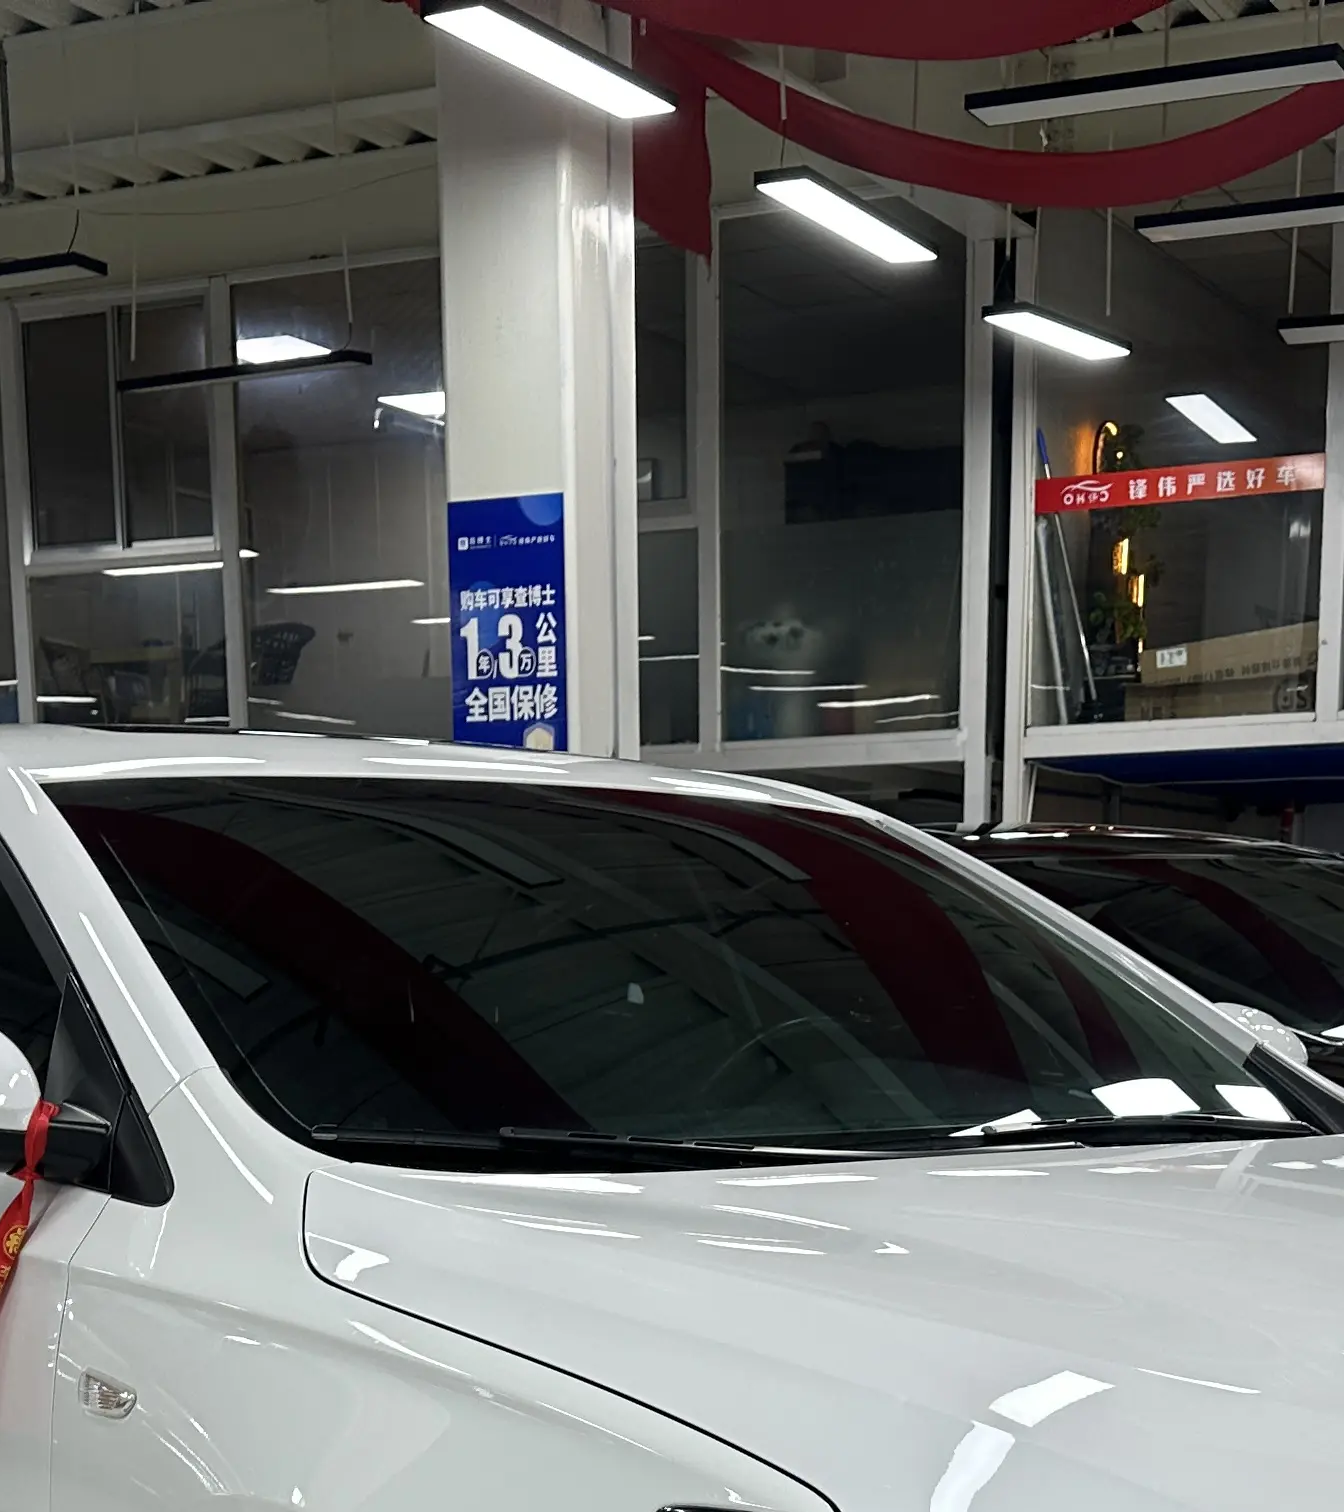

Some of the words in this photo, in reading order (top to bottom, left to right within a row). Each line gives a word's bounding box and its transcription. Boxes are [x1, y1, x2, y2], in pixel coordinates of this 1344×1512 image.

[1128, 464, 1297, 500] 锋伟严选好车
[460, 584, 556, 611] 购车可享查博士
[465, 683, 558, 723] 全国保修
